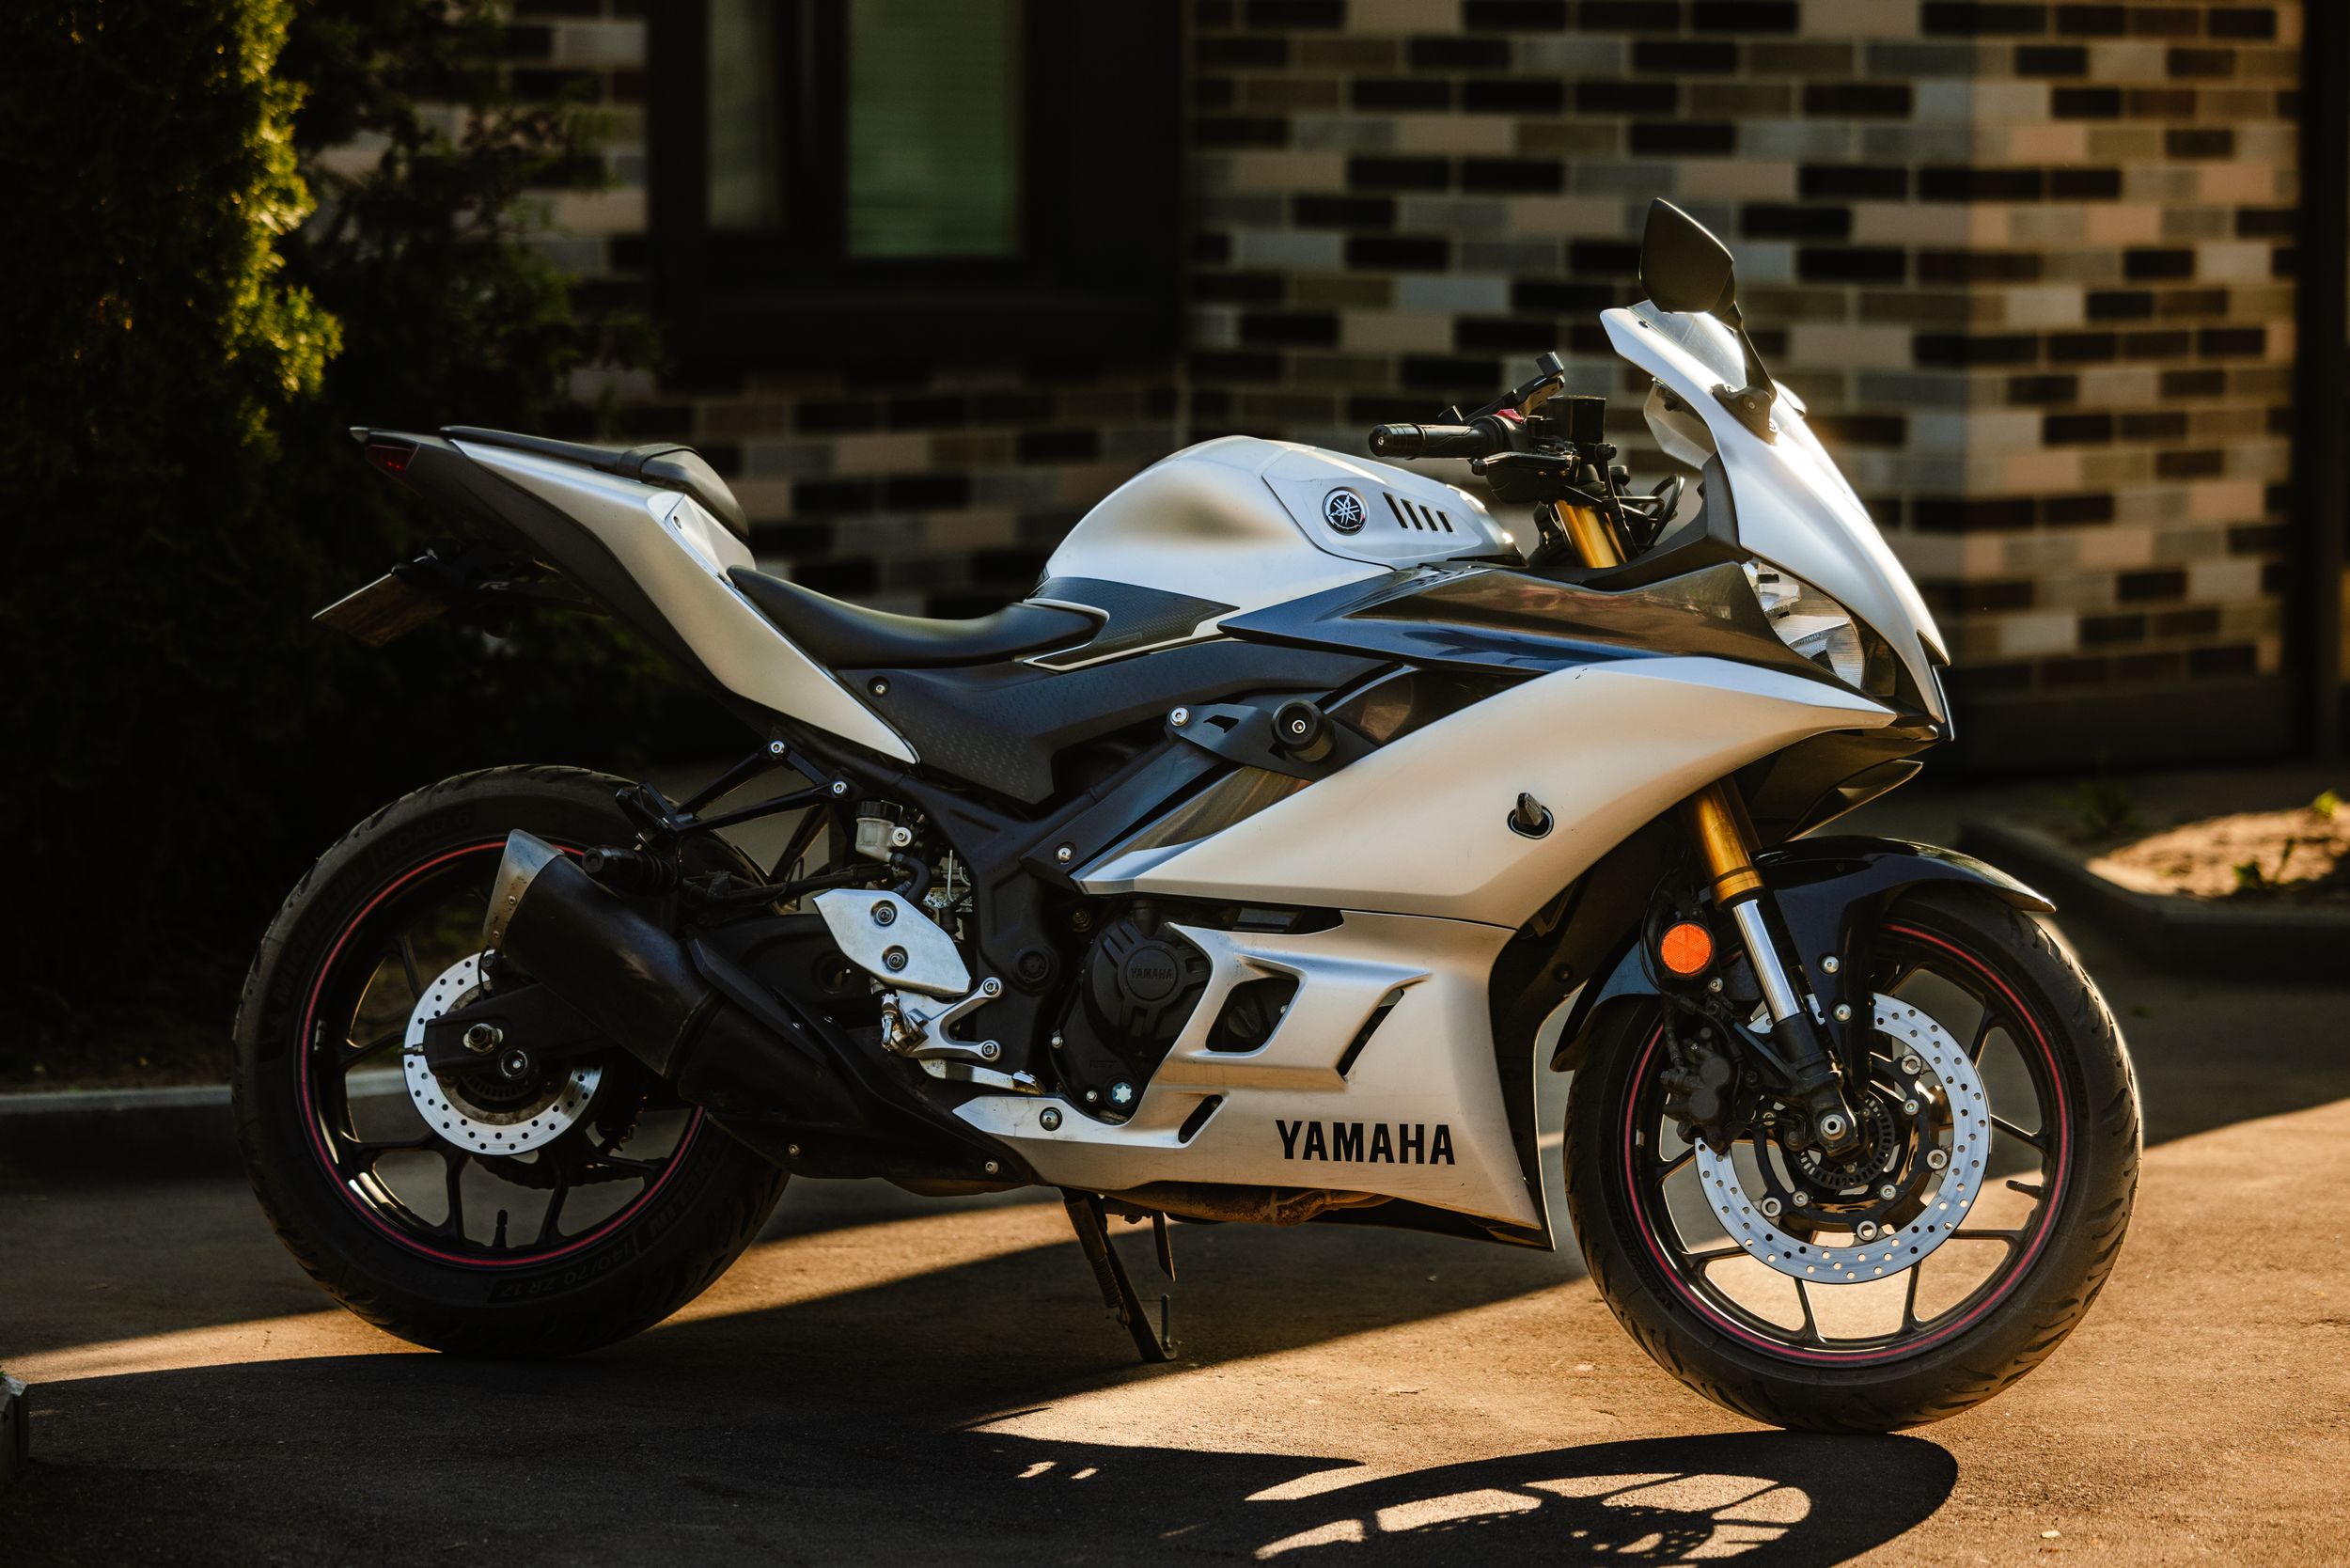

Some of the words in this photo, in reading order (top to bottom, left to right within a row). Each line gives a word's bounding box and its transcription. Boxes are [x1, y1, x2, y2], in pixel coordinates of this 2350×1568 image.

[380, 815, 446, 863] ROAD
[1131, 967, 1173, 979] YAMAHA
[1276, 1120, 1455, 1165] YAMAHA
[564, 1241, 632, 1285] 140/70
[528, 1278, 557, 1294] ZR
